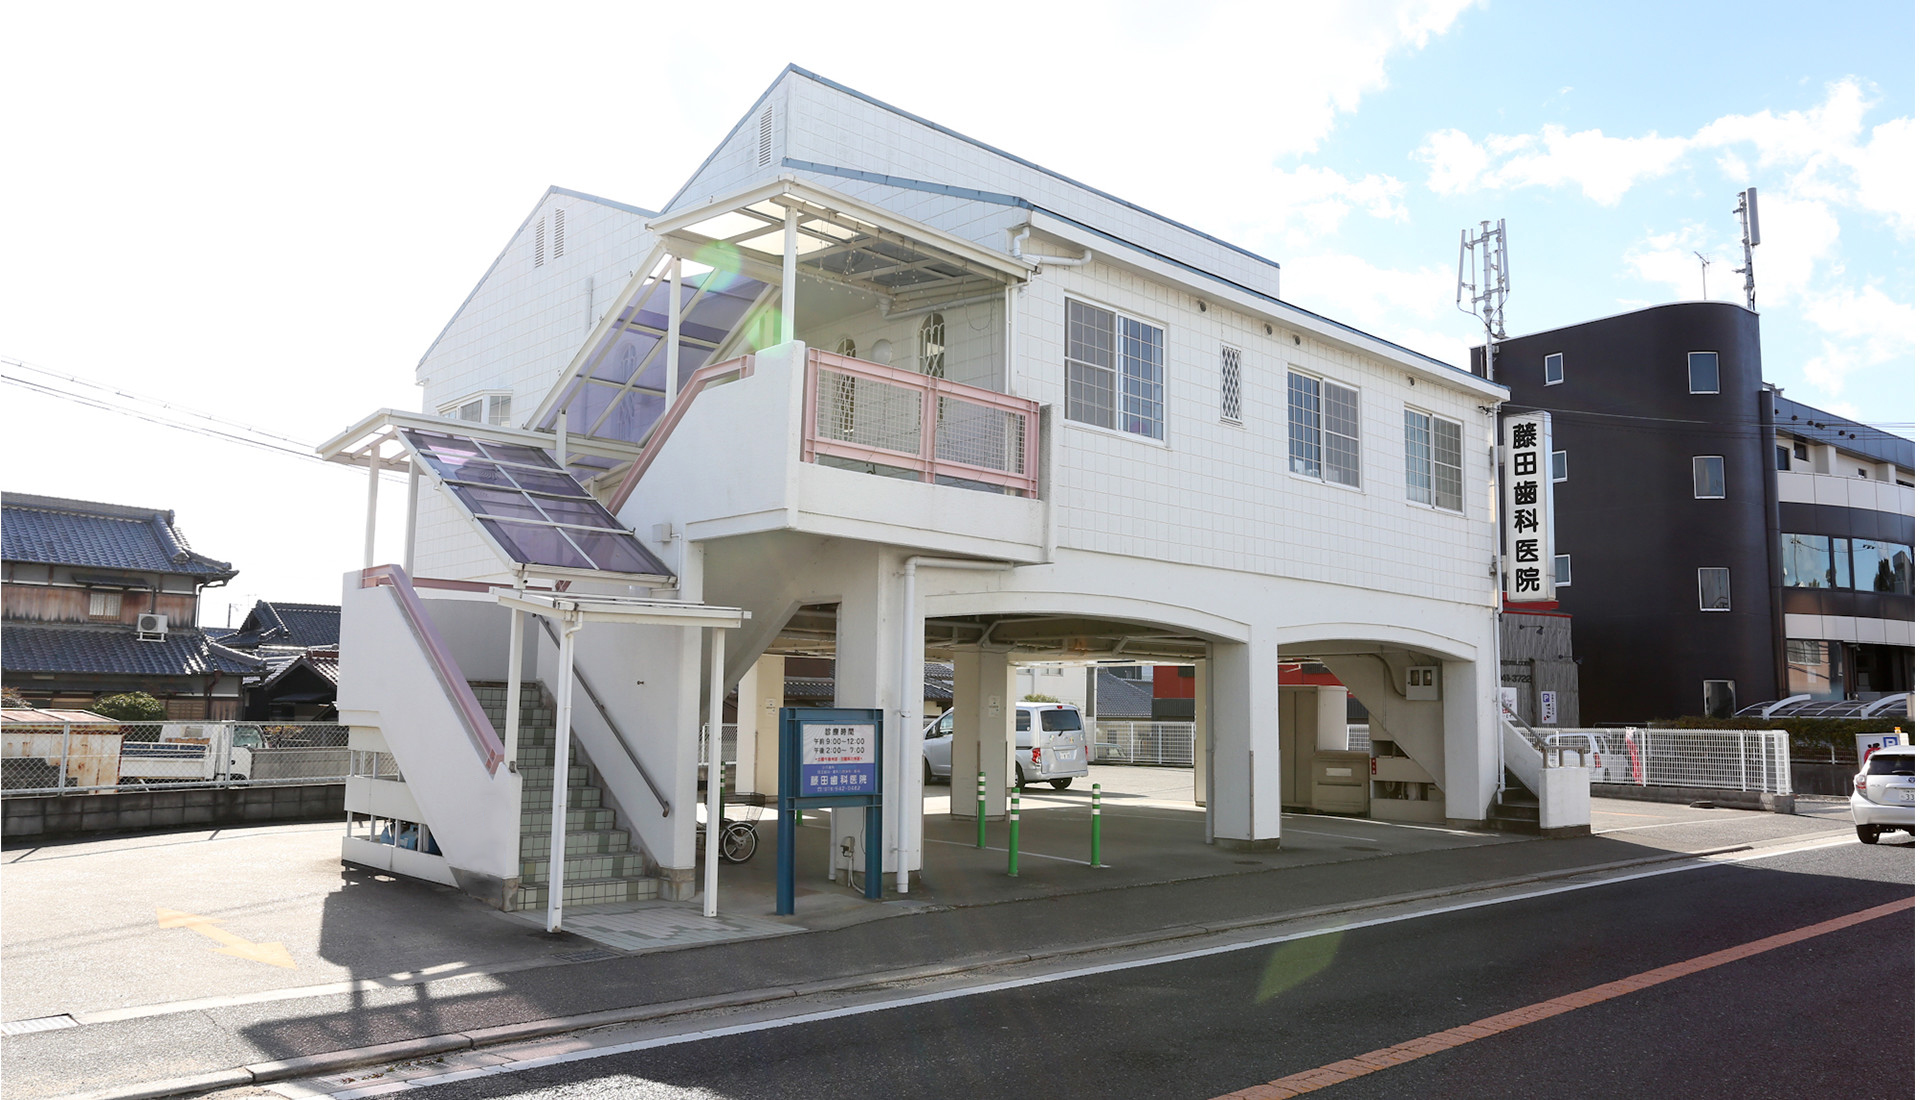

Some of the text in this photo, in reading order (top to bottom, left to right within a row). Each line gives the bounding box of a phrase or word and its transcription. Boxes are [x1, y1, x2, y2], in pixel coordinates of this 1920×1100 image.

[1512, 422, 1540, 593] 藤田歯科医院
[825, 728, 855, 736] 診療時間
[810, 775, 867, 786] 藤田歯科医院
